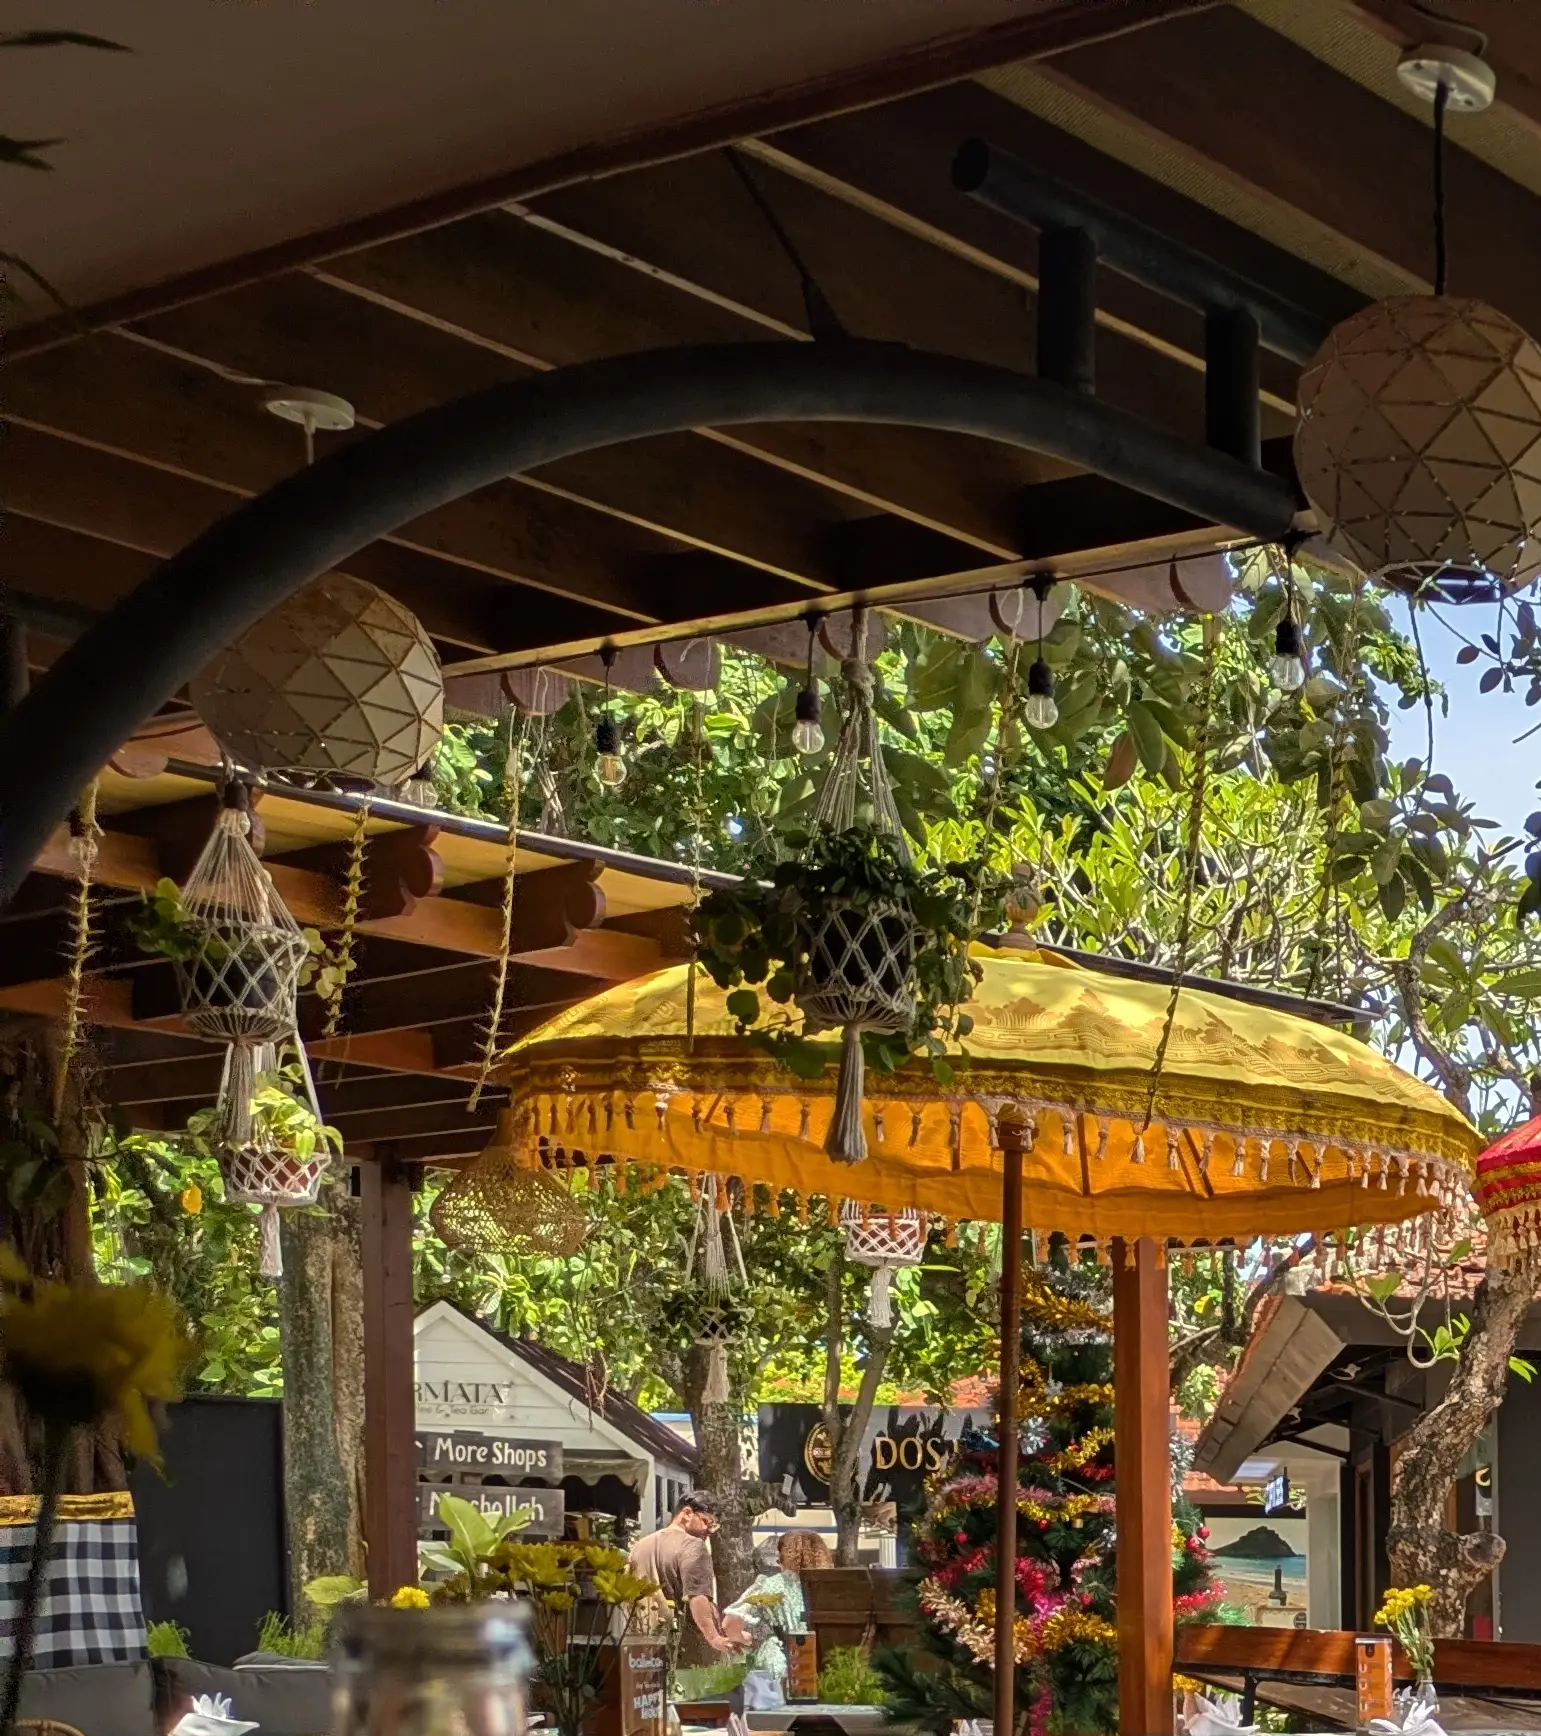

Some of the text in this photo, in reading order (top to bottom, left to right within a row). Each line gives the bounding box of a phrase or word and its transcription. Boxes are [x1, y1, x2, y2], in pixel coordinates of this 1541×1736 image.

[434, 1438, 547, 1472] More Shops
[874, 1436, 941, 1470] DOS
